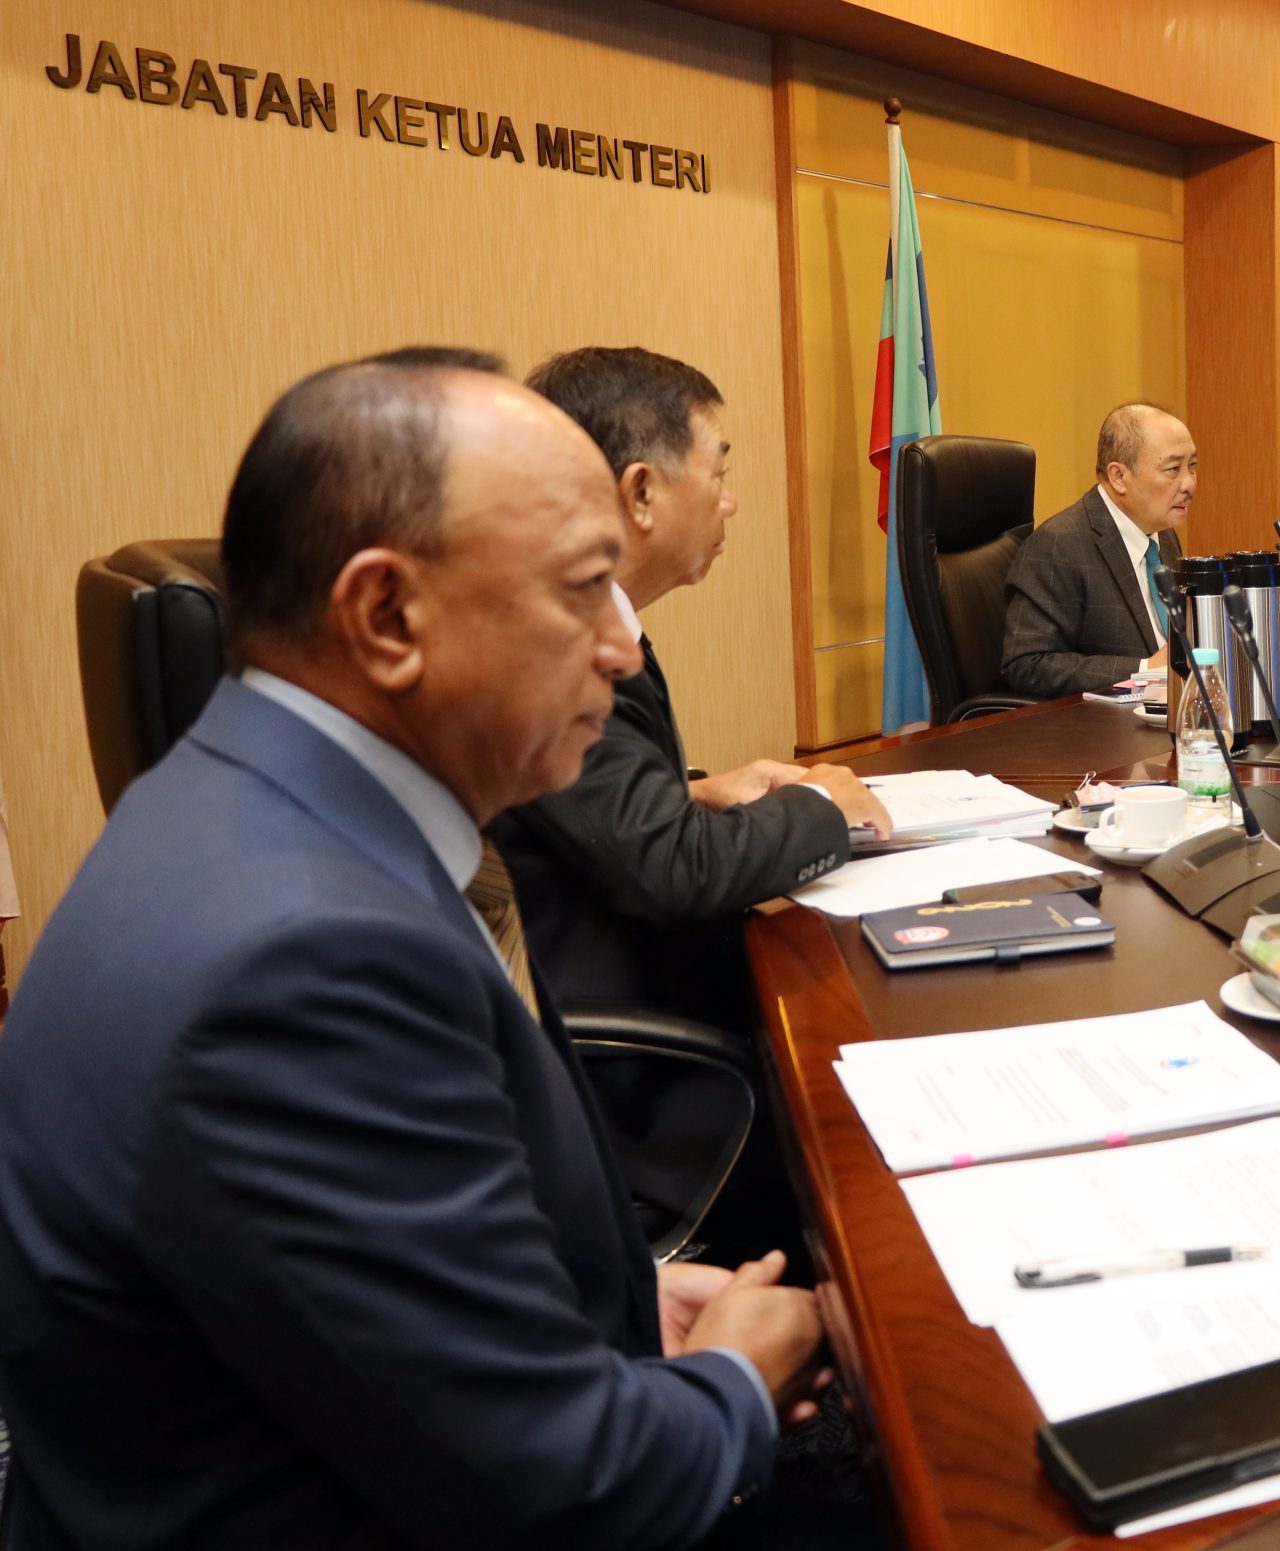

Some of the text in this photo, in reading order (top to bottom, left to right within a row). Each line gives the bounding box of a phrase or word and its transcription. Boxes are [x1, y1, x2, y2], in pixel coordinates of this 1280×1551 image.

[46, 33, 711, 193] JABATAN KETUA MENTERI
